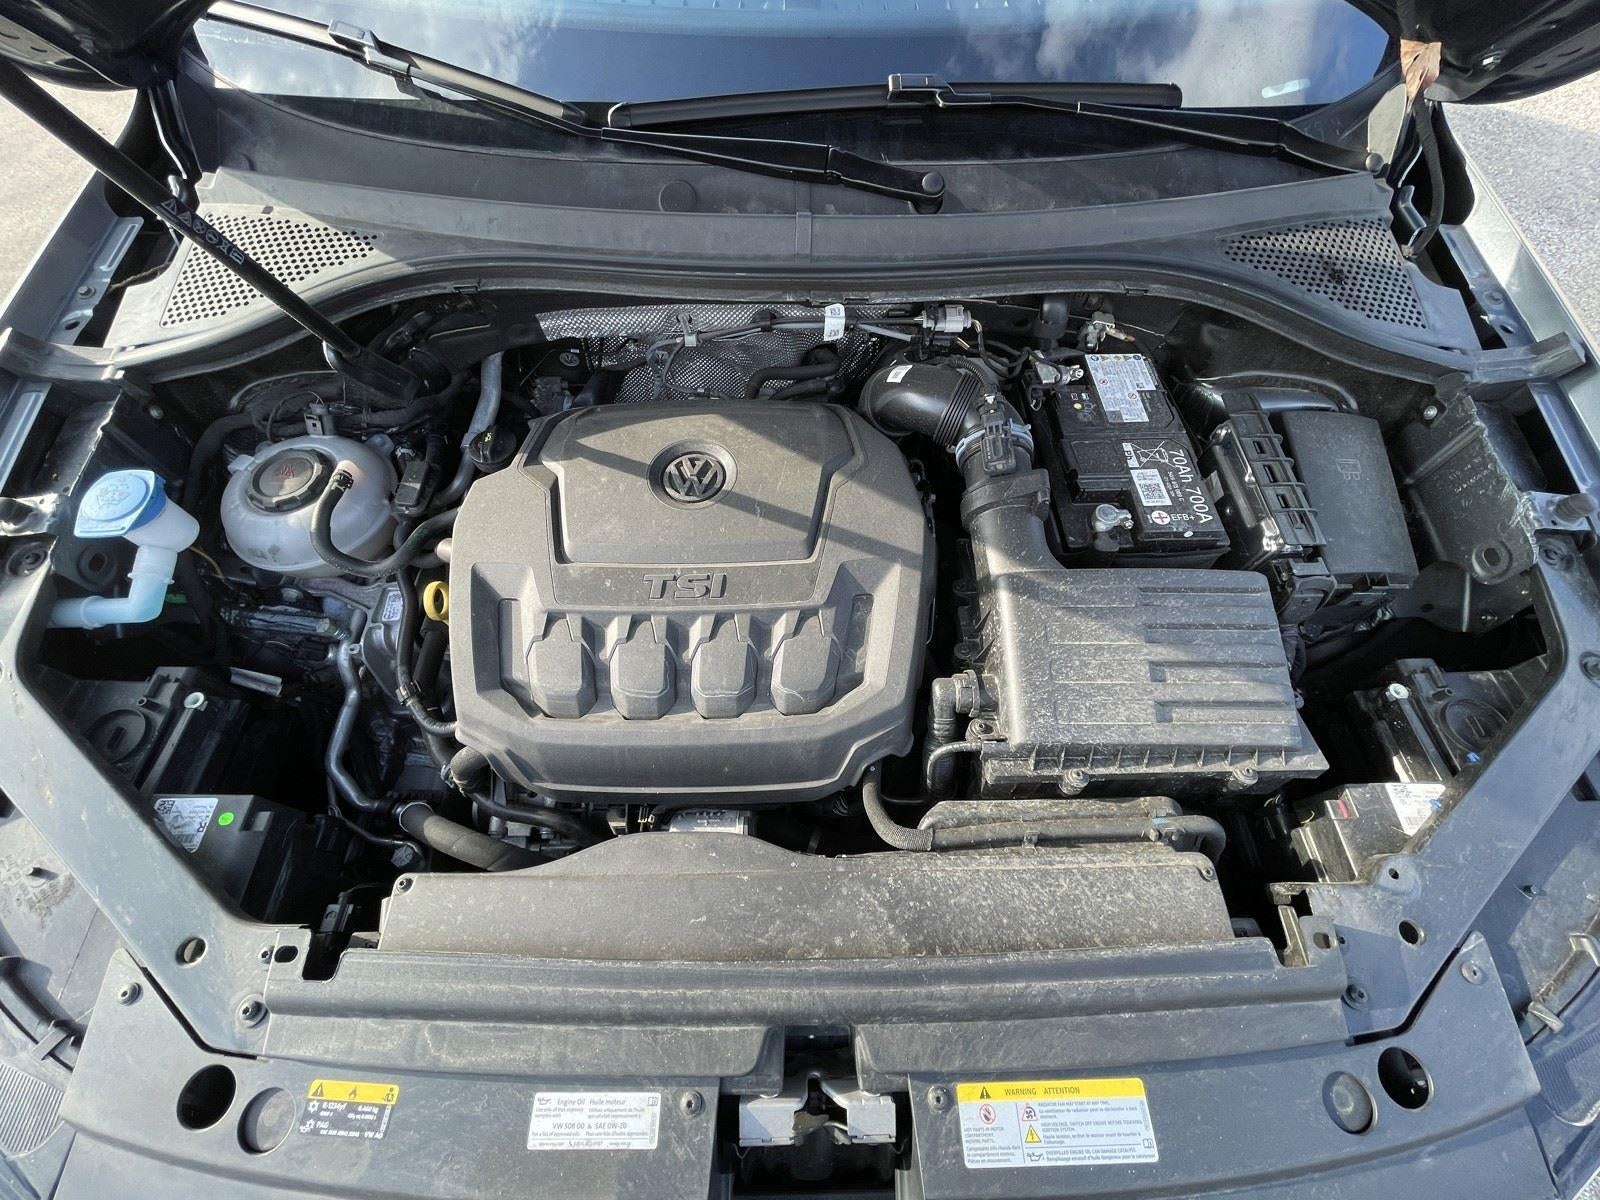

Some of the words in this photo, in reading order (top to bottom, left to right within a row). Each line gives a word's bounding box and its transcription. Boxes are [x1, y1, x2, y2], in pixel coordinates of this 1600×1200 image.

[1169, 449, 1194, 482] 70Ah
[1186, 486, 1213, 523] 700A
[1171, 513, 1196, 521] EFB+
[642, 573, 728, 600] TSI
[1004, 1087, 1037, 1096] WARNING
[1042, 1086, 1080, 1094] ATTENTION
[316, 1121, 329, 1129] PAG
